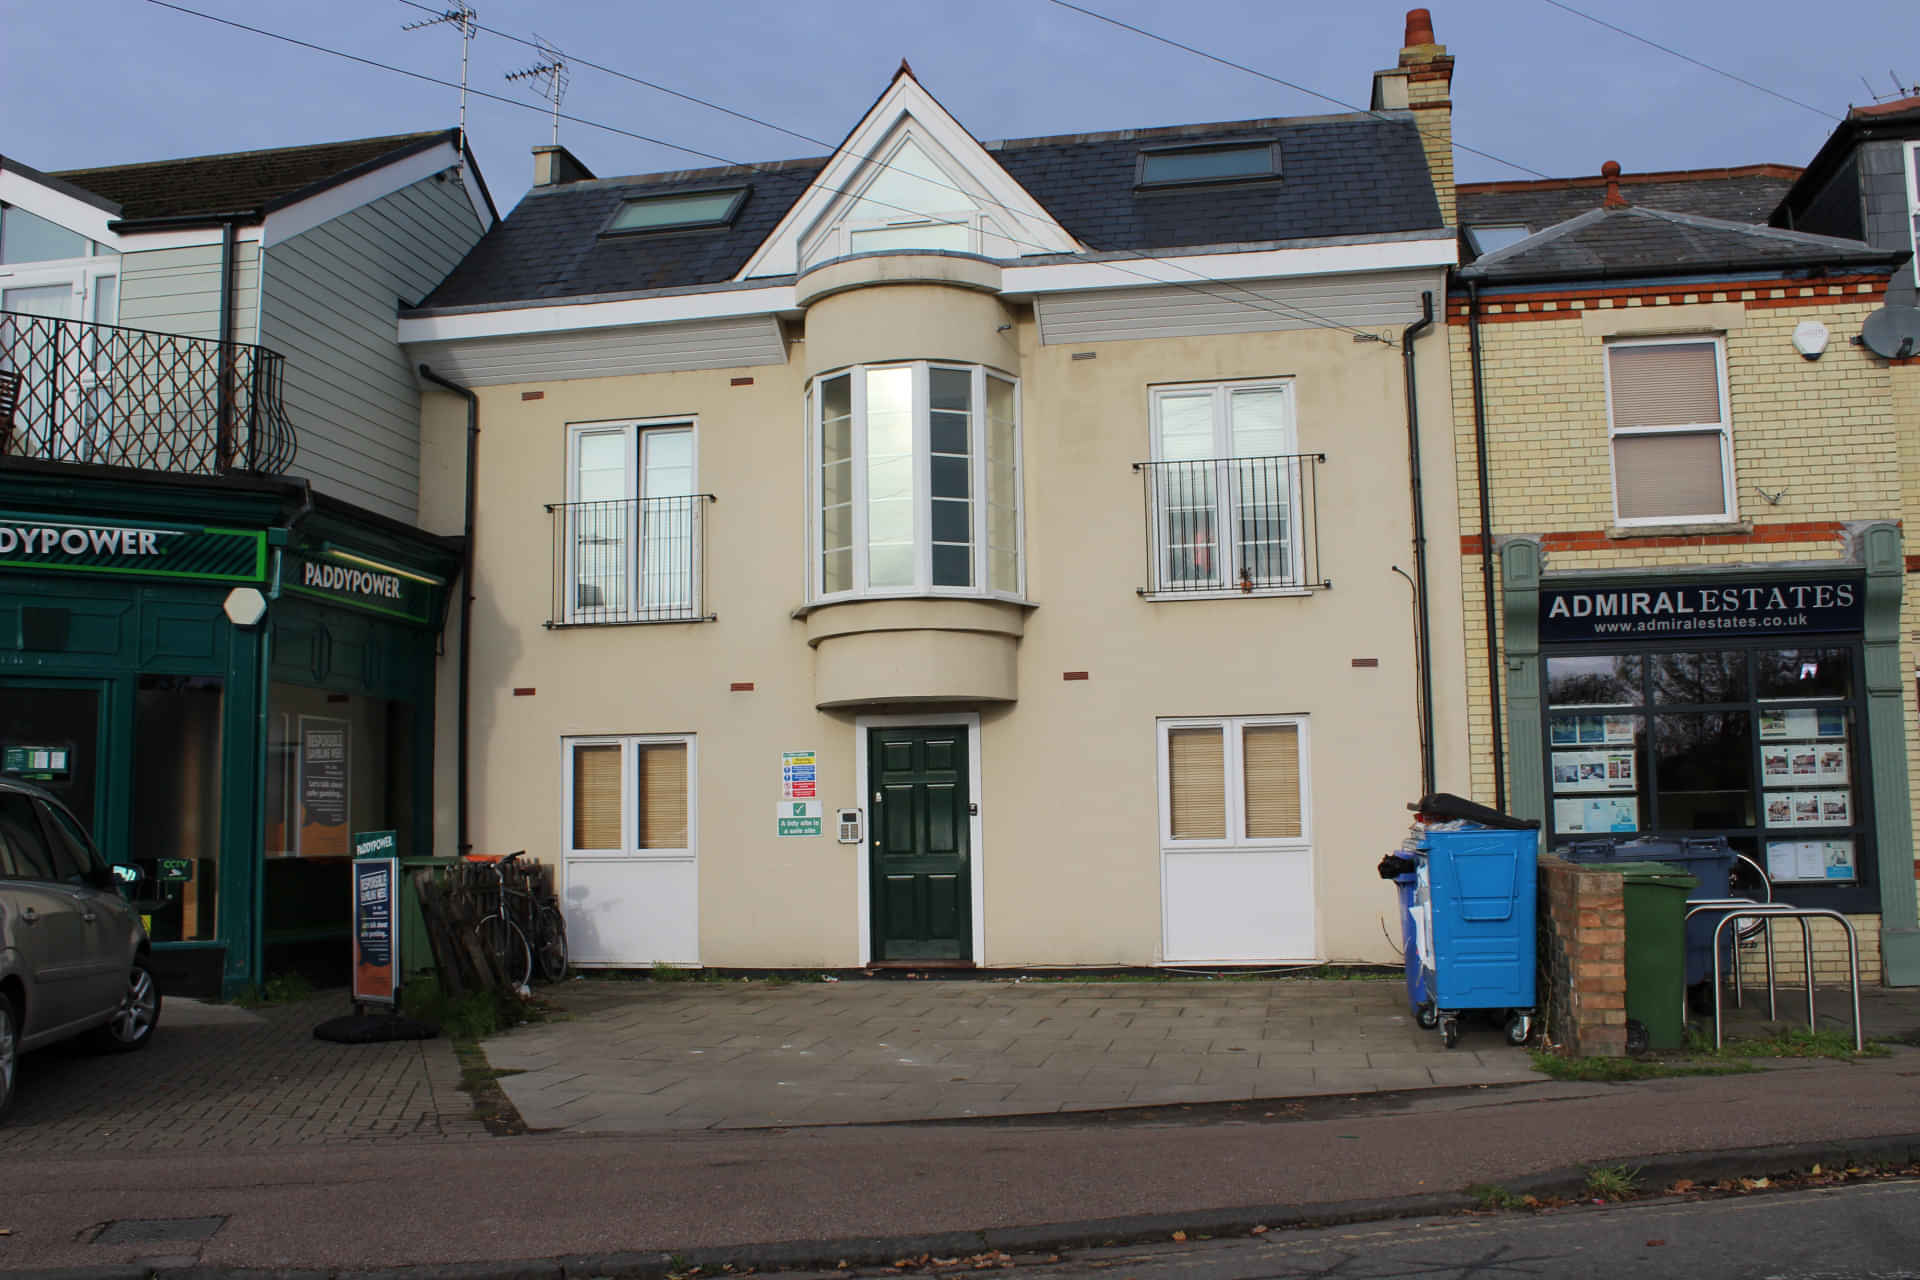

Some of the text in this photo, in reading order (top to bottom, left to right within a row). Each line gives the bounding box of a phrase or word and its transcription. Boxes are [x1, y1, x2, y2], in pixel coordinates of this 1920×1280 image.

[1548, 584, 1854, 618] ADMIRAL ESTATES
[1594, 613, 1808, 633] www.admiralestates.co.uk
